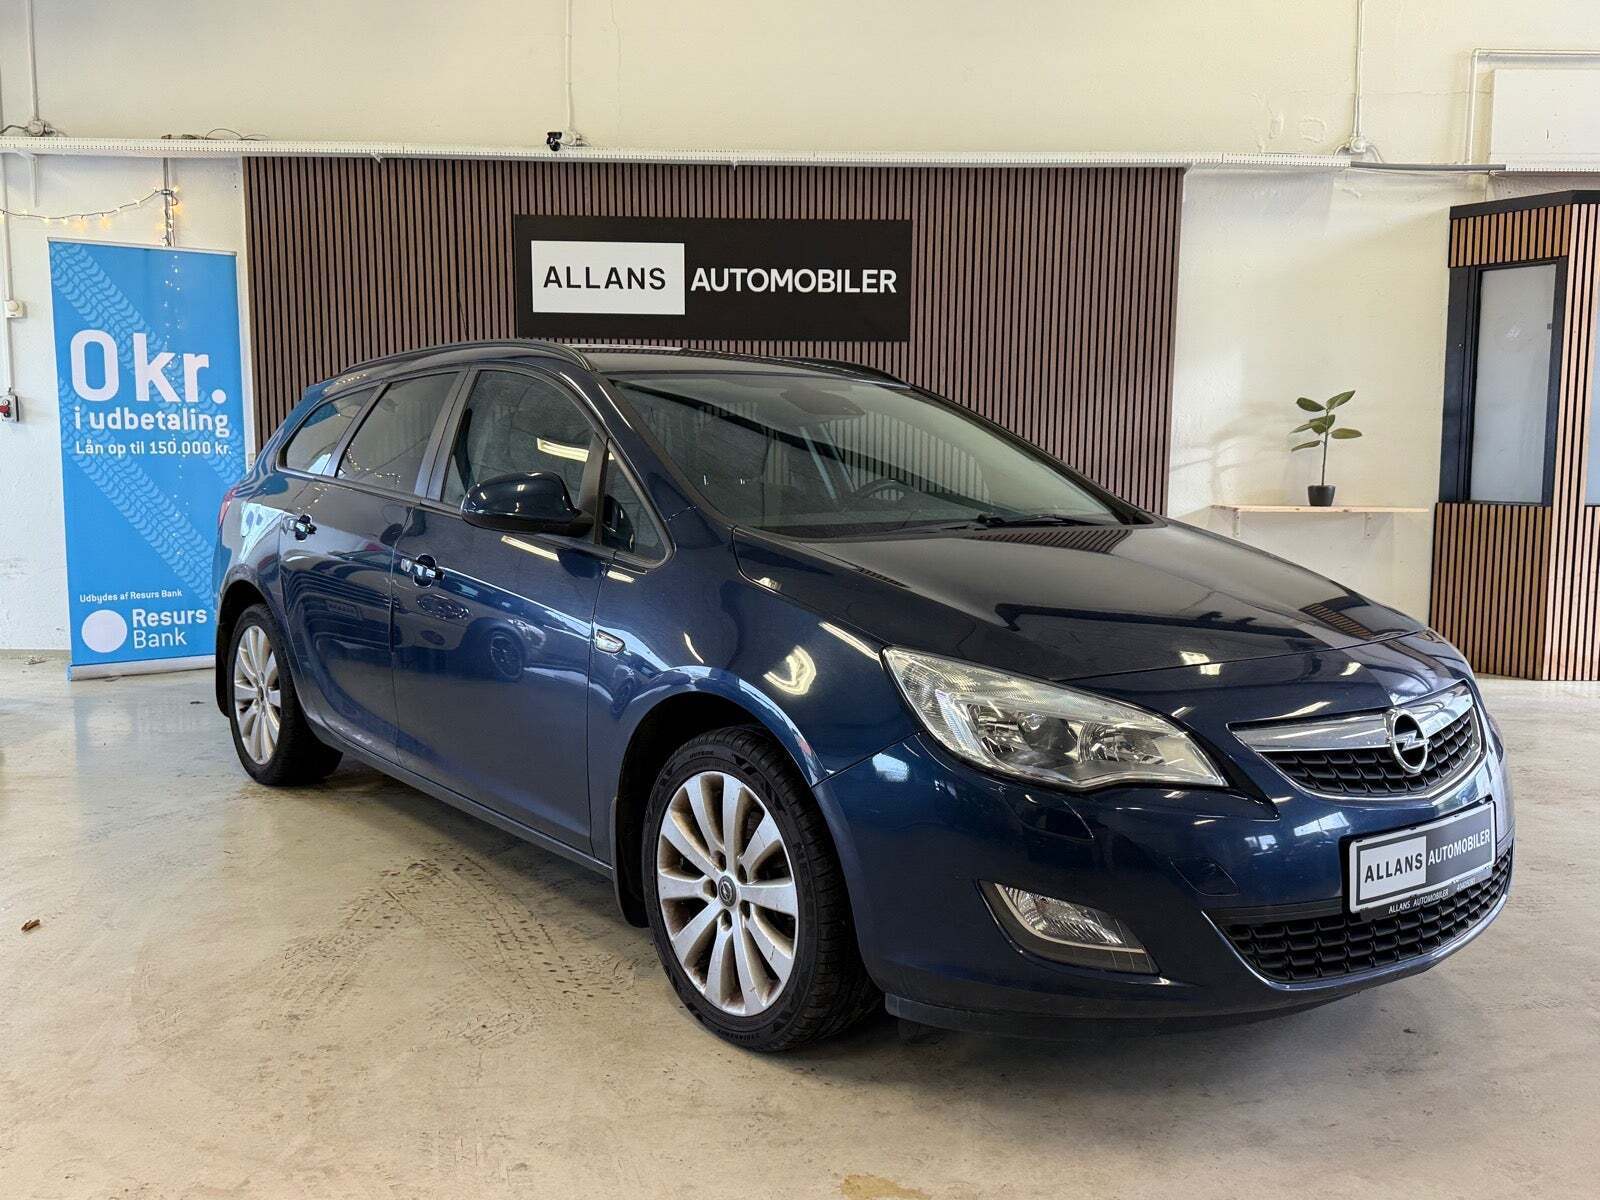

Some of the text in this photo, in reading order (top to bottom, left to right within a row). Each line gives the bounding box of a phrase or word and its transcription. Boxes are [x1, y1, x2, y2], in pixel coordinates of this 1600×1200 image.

[543, 265, 897, 294] ALLANS AUTOMOBILER
[70, 329, 227, 404] 0 kr.
[74, 406, 230, 438] i udbetaling
[76, 439, 232, 458] Lån op til 150.000 kr.
[79, 588, 183, 604] Udbydes af Resurs Bank
[132, 608, 207, 628] Resurs
[133, 627, 188, 649] Bank
[1364, 828, 1491, 884] ALLANS AUTOMOBILER
[1388, 888, 1449, 915] ALLANS AUTOMOBILER
